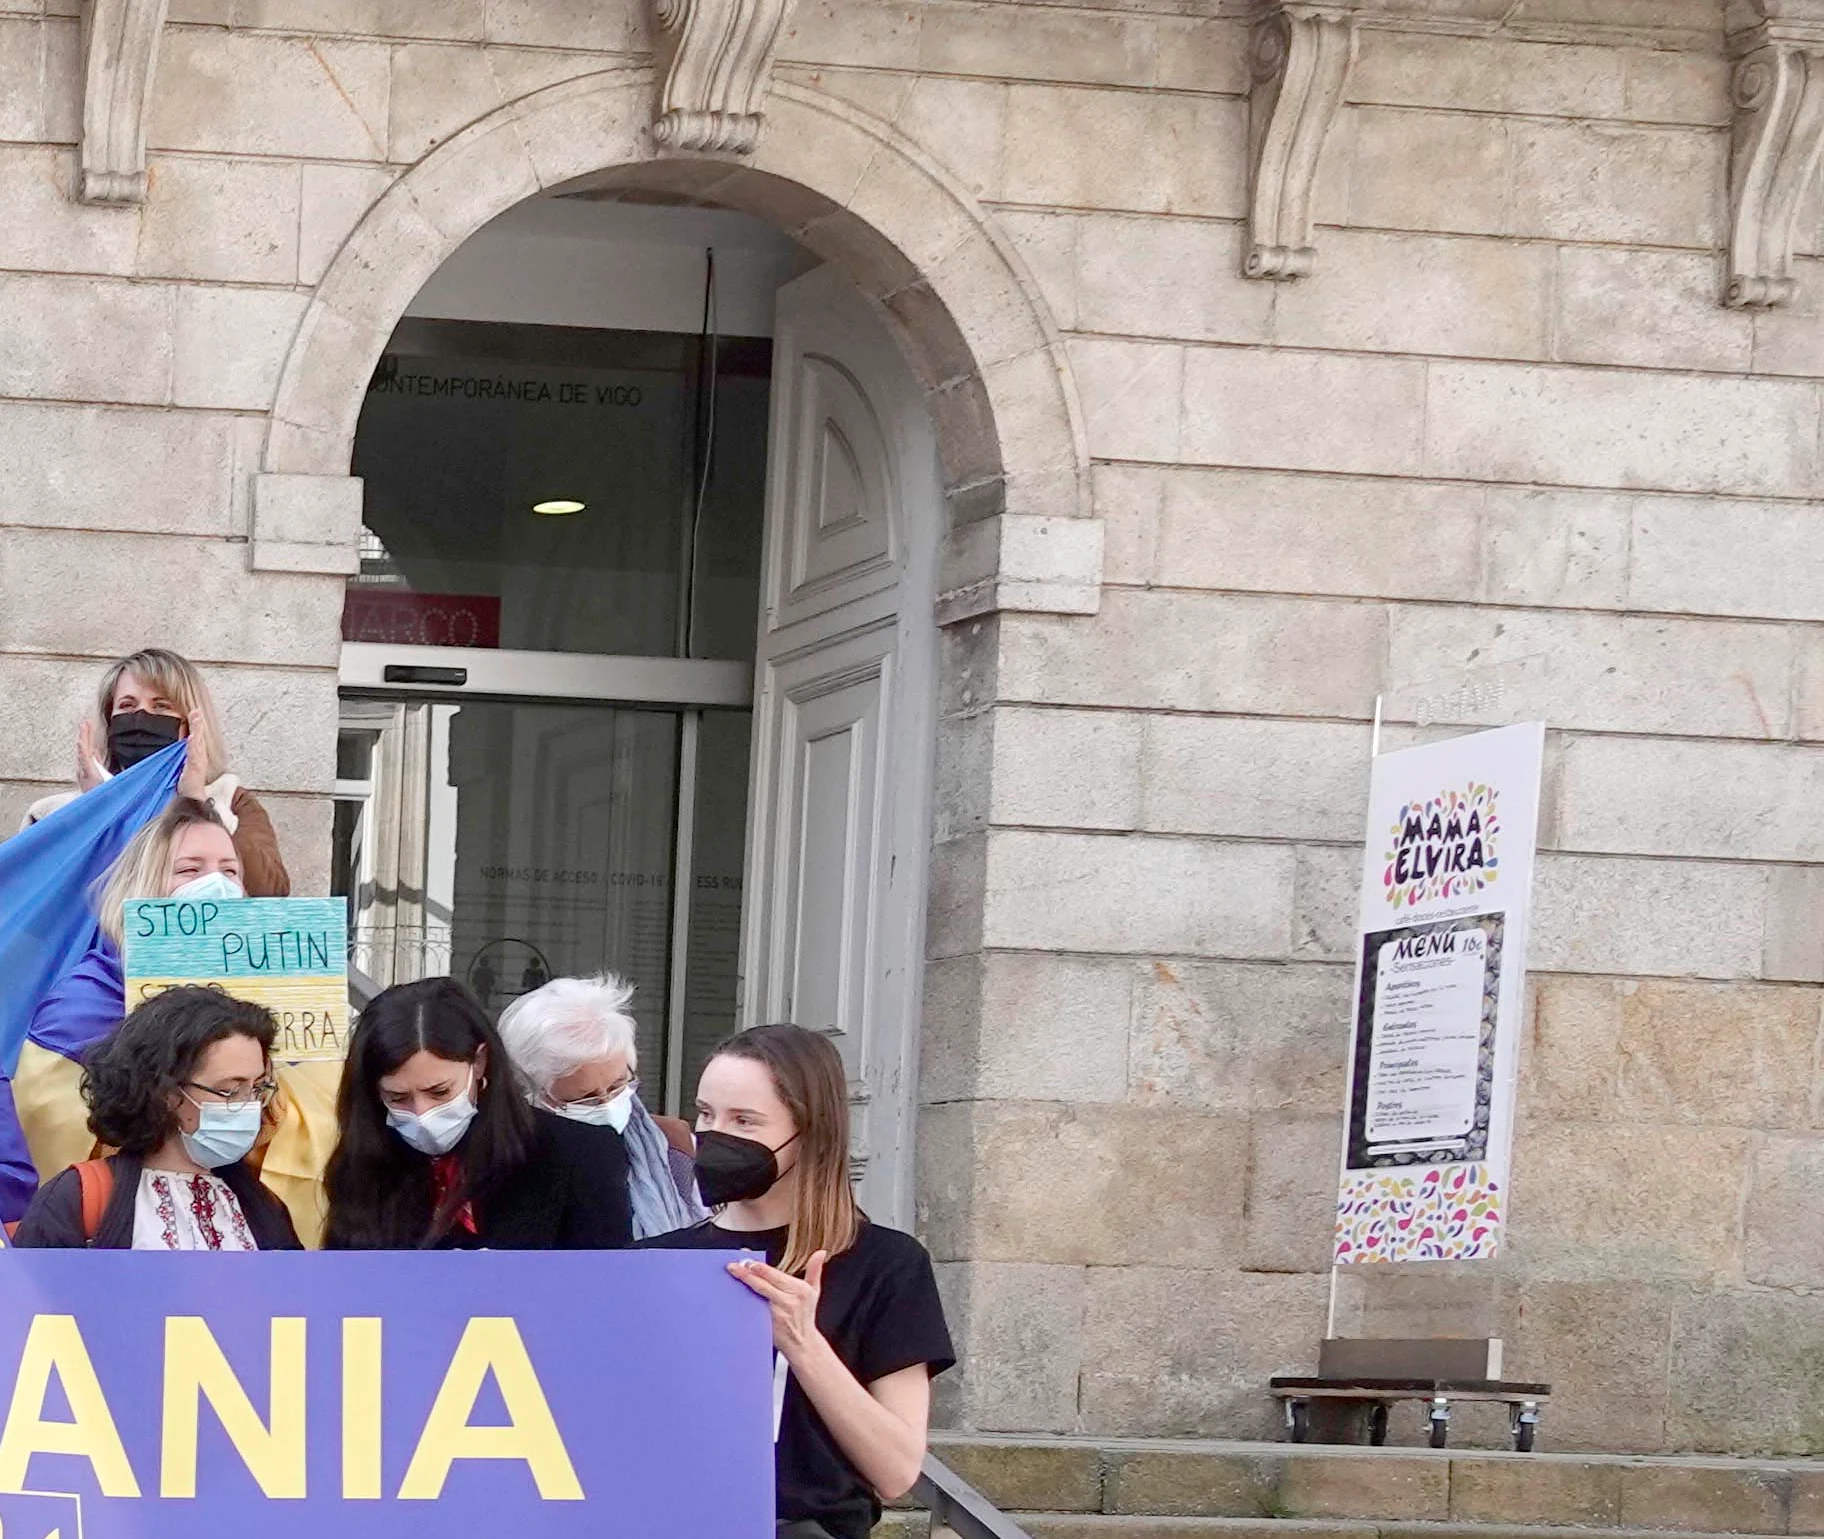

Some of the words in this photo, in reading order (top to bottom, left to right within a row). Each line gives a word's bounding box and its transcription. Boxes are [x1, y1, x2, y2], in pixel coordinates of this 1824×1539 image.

[561, 384, 588, 403] DE
[596, 385, 642, 407] VIGO
[345, 605, 479, 647] ARCO
[1400, 809, 1481, 848] MAMA
[1394, 837, 1484, 884] ELVIRA
[137, 903, 219, 937] STOP
[222, 931, 329, 972] PUTIN
